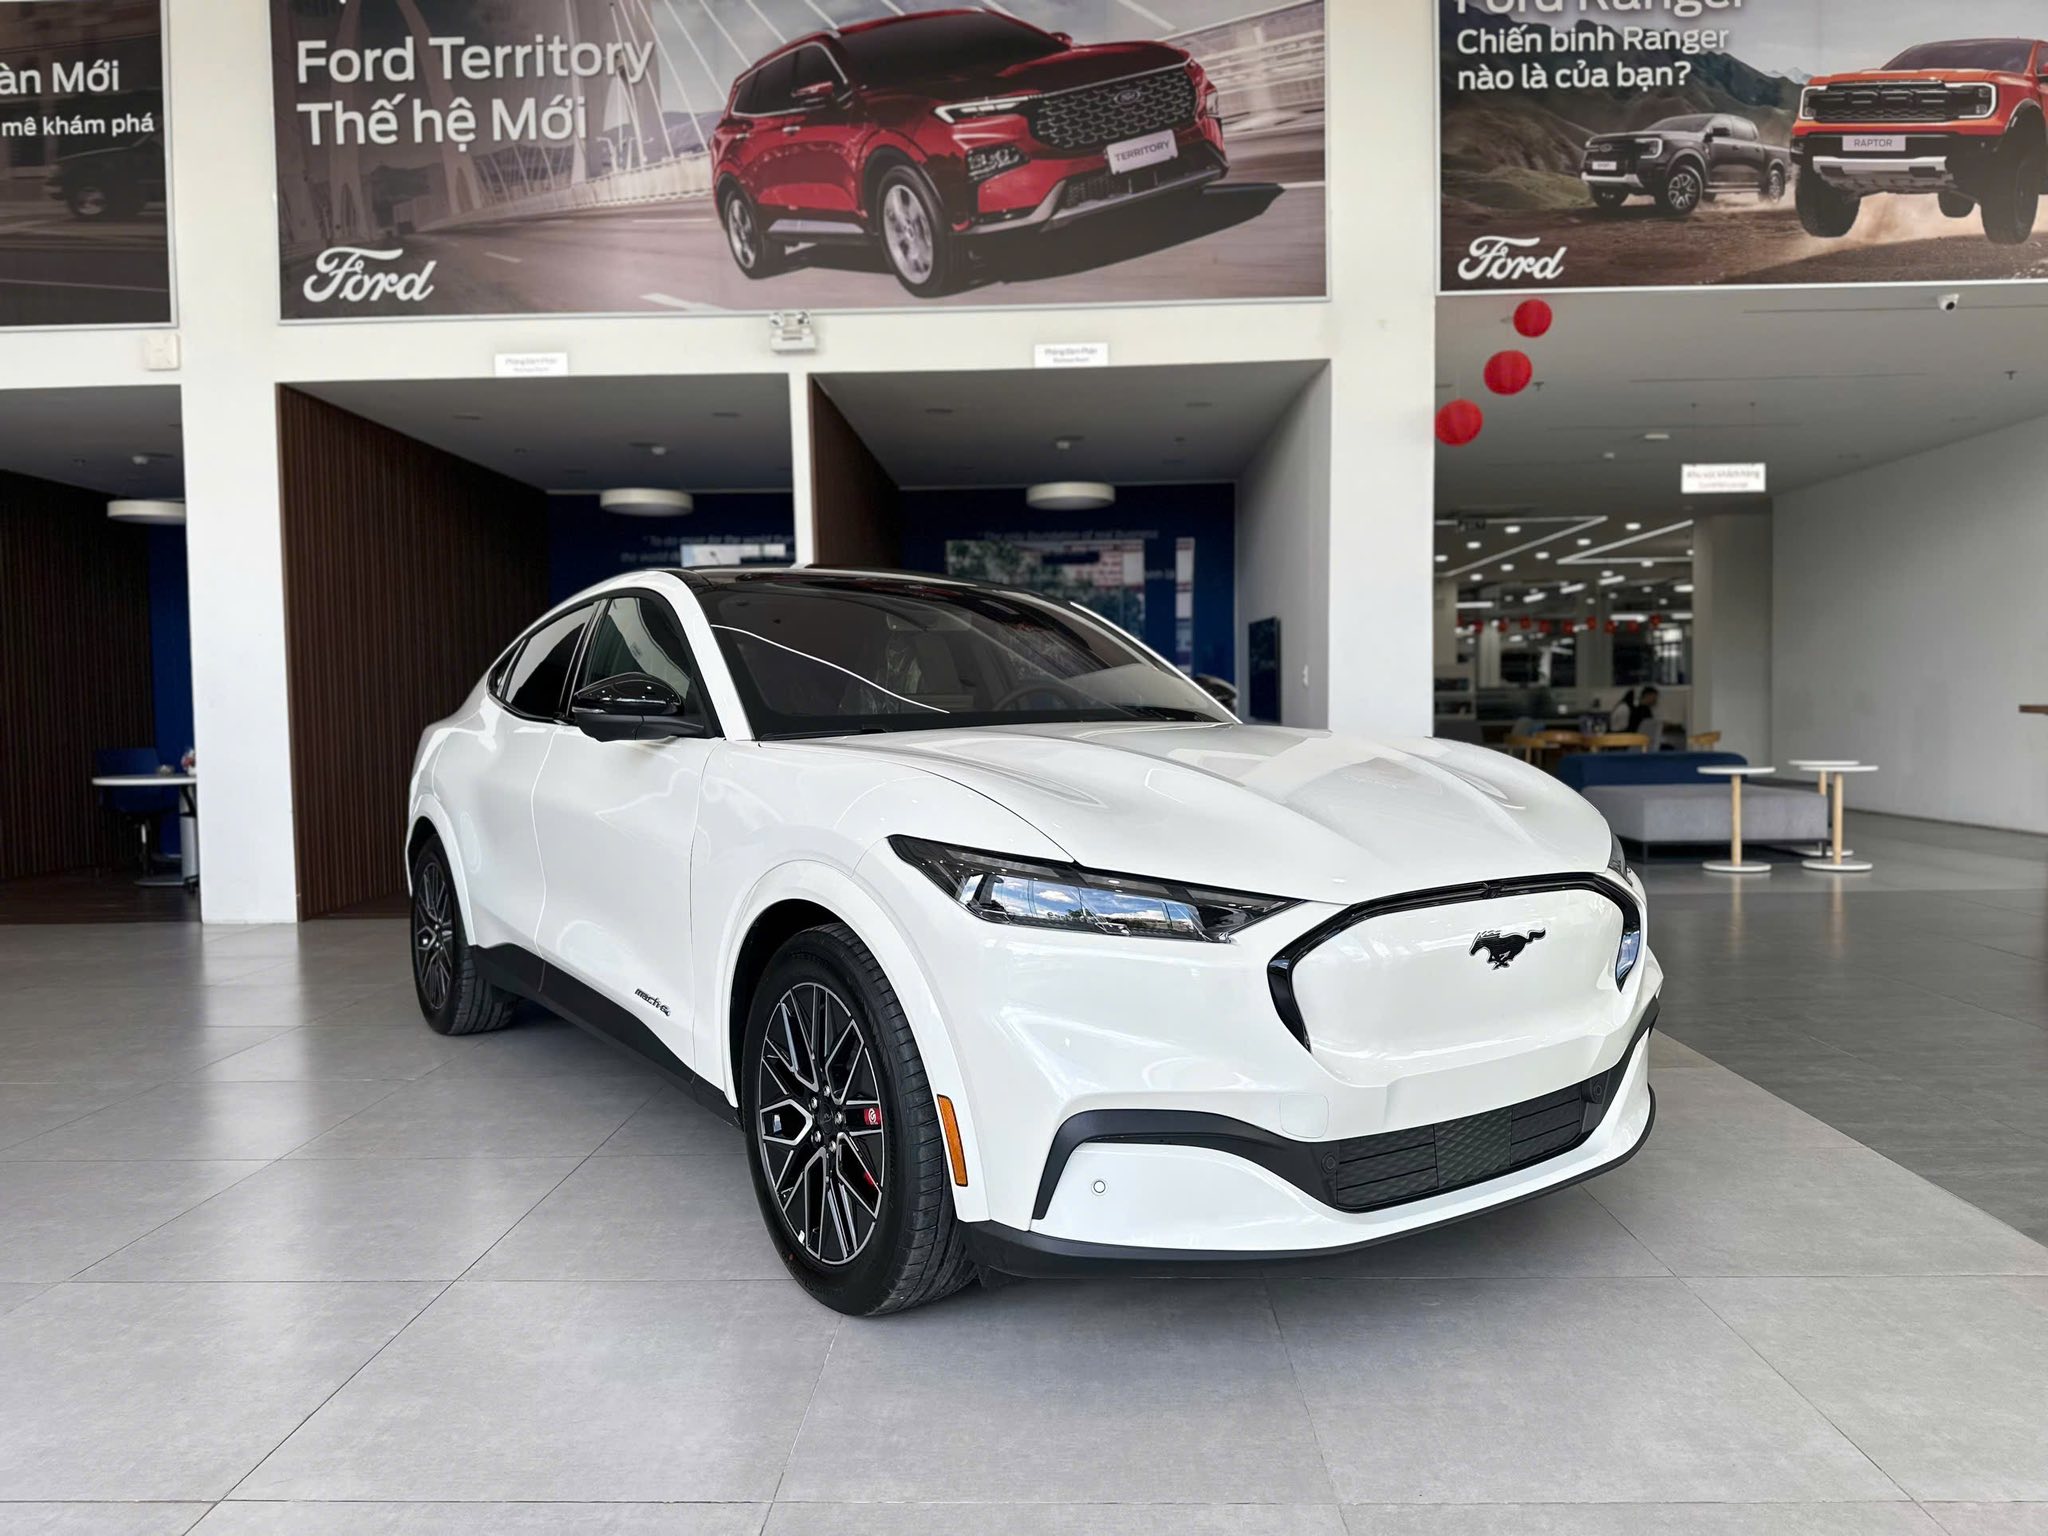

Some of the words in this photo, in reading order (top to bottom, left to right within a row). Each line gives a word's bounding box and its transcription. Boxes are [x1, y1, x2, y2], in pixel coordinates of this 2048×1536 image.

[1457, 25, 1542, 54] Chiến
[1550, 26, 1614, 51] binh
[1623, 27, 1729, 54] Ranger
[298, 36, 414, 83] Ford
[428, 34, 653, 83] Territory
[52, 59, 119, 93] Mới
[1458, 64, 1514, 90] nào
[1521, 63, 1548, 89] là
[1555, 60, 1609, 88] của
[1617, 61, 1691, 91] bạn?
[2, 117, 36, 136] mê
[42, 115, 105, 136] khám
[112, 112, 155, 138] phá
[297, 93, 405, 146] Thế
[412, 97, 476, 152] hệ
[491, 95, 587, 141] Mới
[1115, 141, 1169, 161] TERRITORY
[1854, 139, 1893, 147] RAPTOR
[1458, 236, 1566, 280] Ford
[303, 246, 436, 303] Ford
